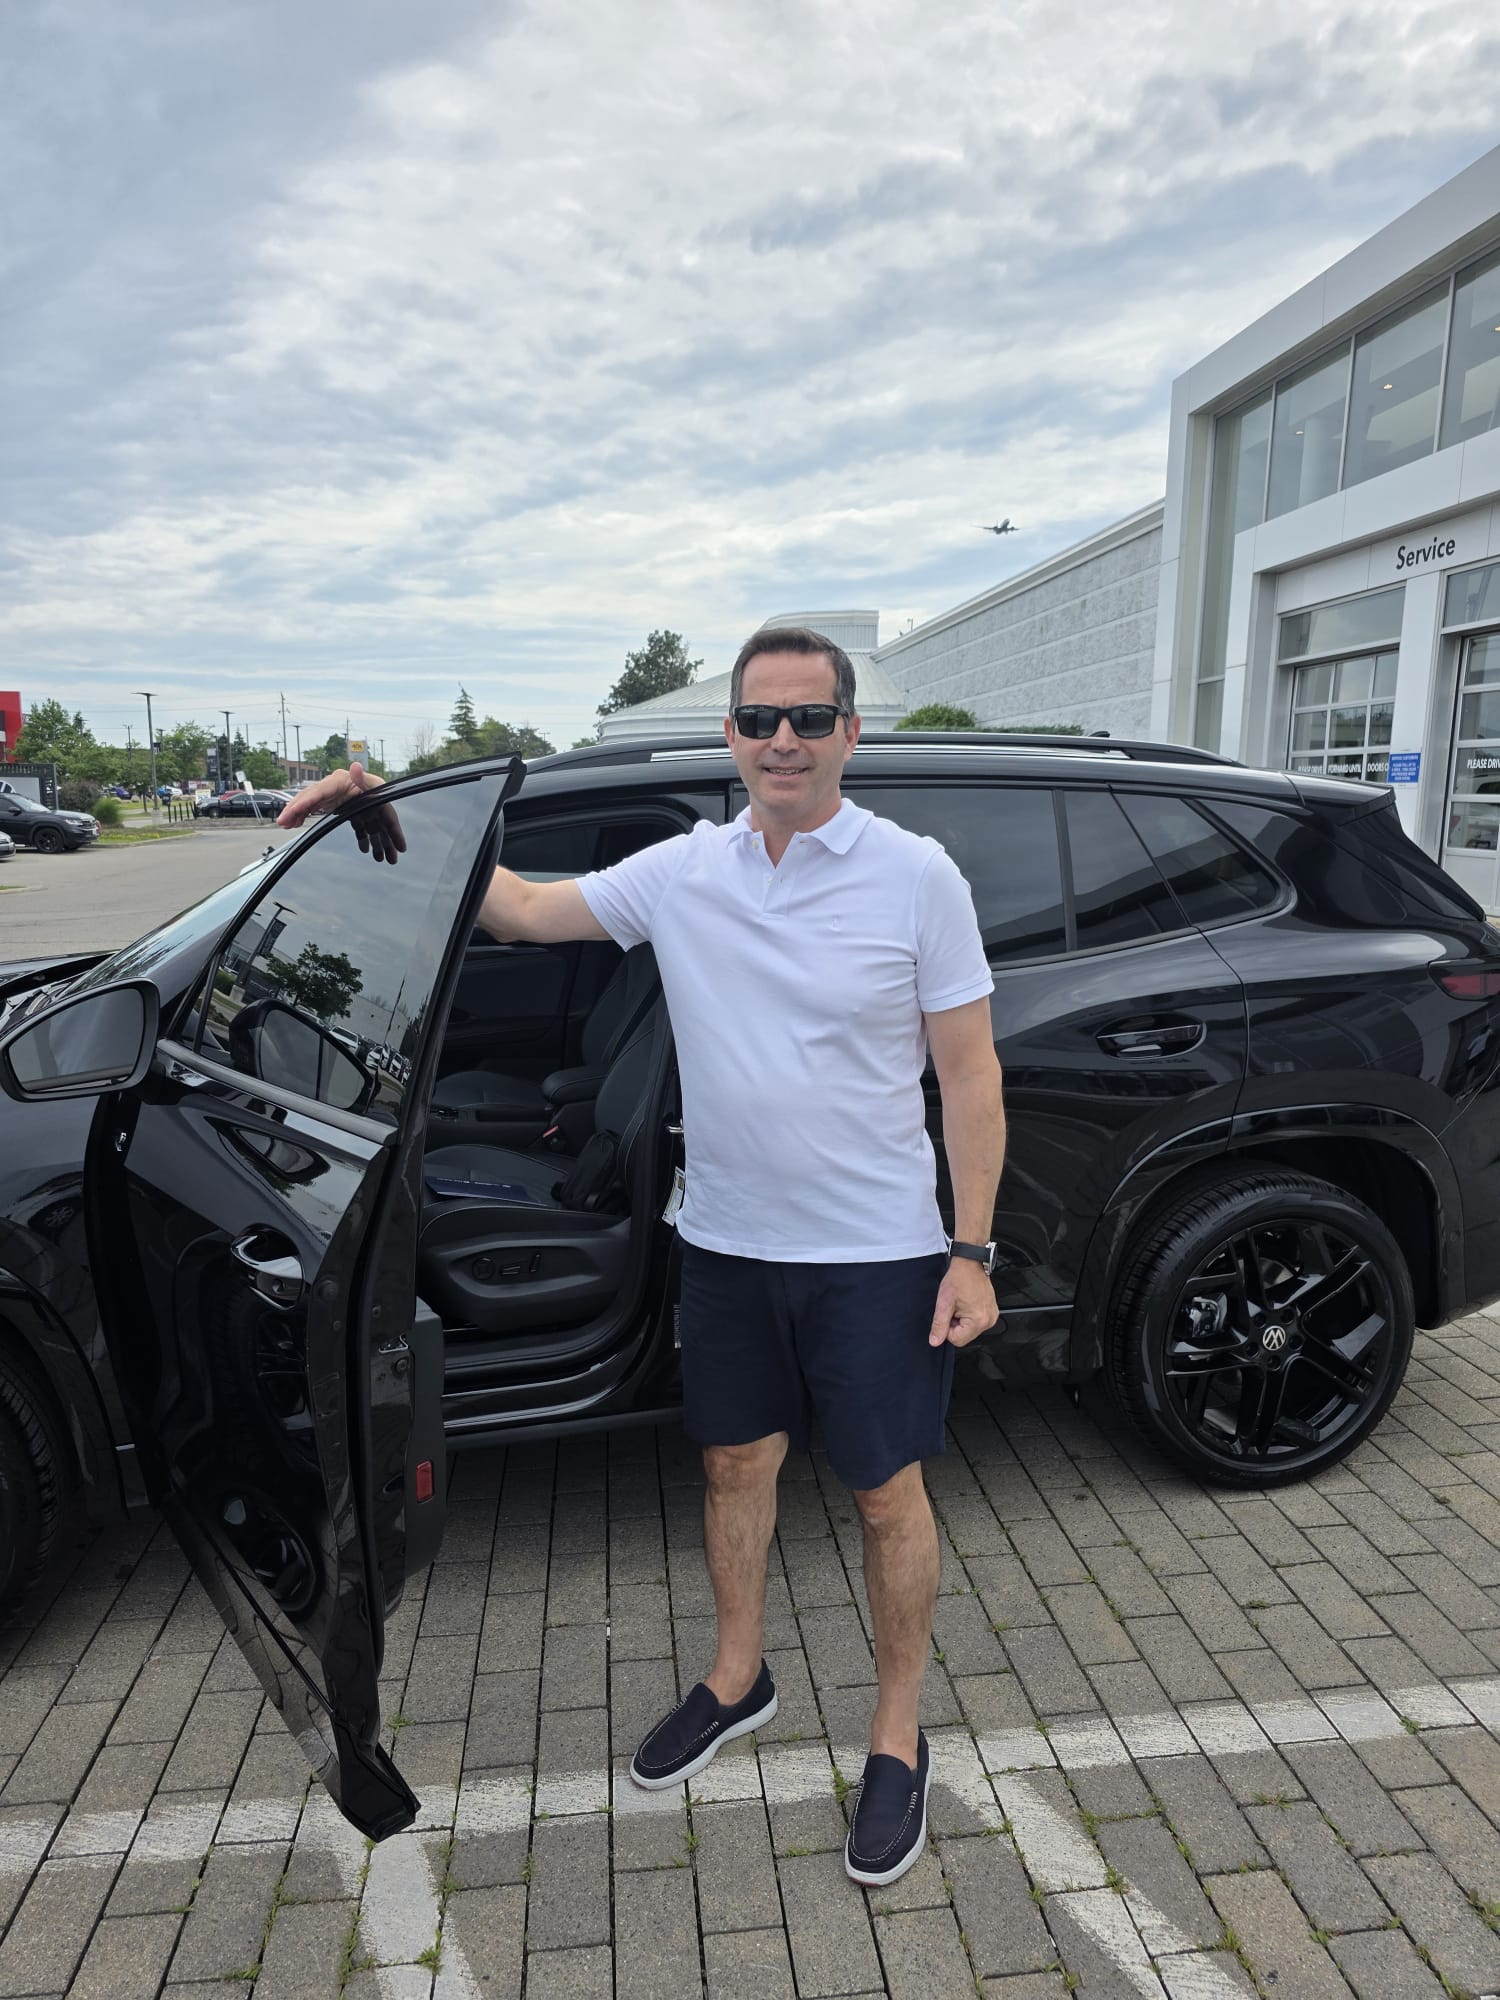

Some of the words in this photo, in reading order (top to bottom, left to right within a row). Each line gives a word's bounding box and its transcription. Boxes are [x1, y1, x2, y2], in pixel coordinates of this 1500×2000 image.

[1396, 536, 1456, 570] Service
[1367, 762, 1384, 772] DOORS
[1467, 758, 1487, 769] PLEASE
